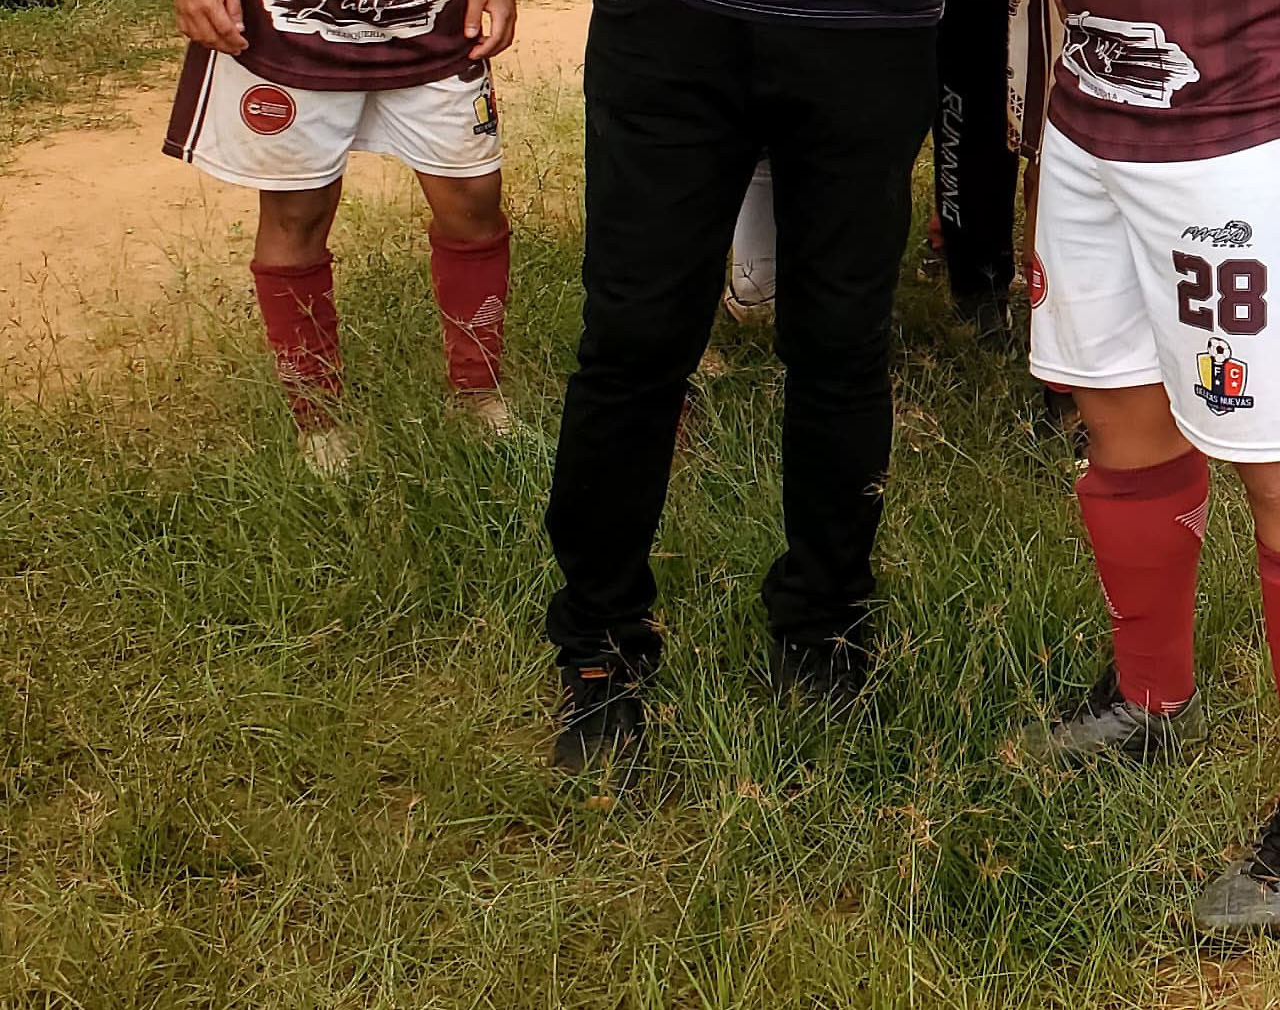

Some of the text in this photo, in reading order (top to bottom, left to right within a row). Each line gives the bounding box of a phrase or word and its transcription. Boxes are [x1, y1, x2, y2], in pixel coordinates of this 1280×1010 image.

[1171, 249, 1268, 336] 28
[1213, 366, 1240, 379] F C
